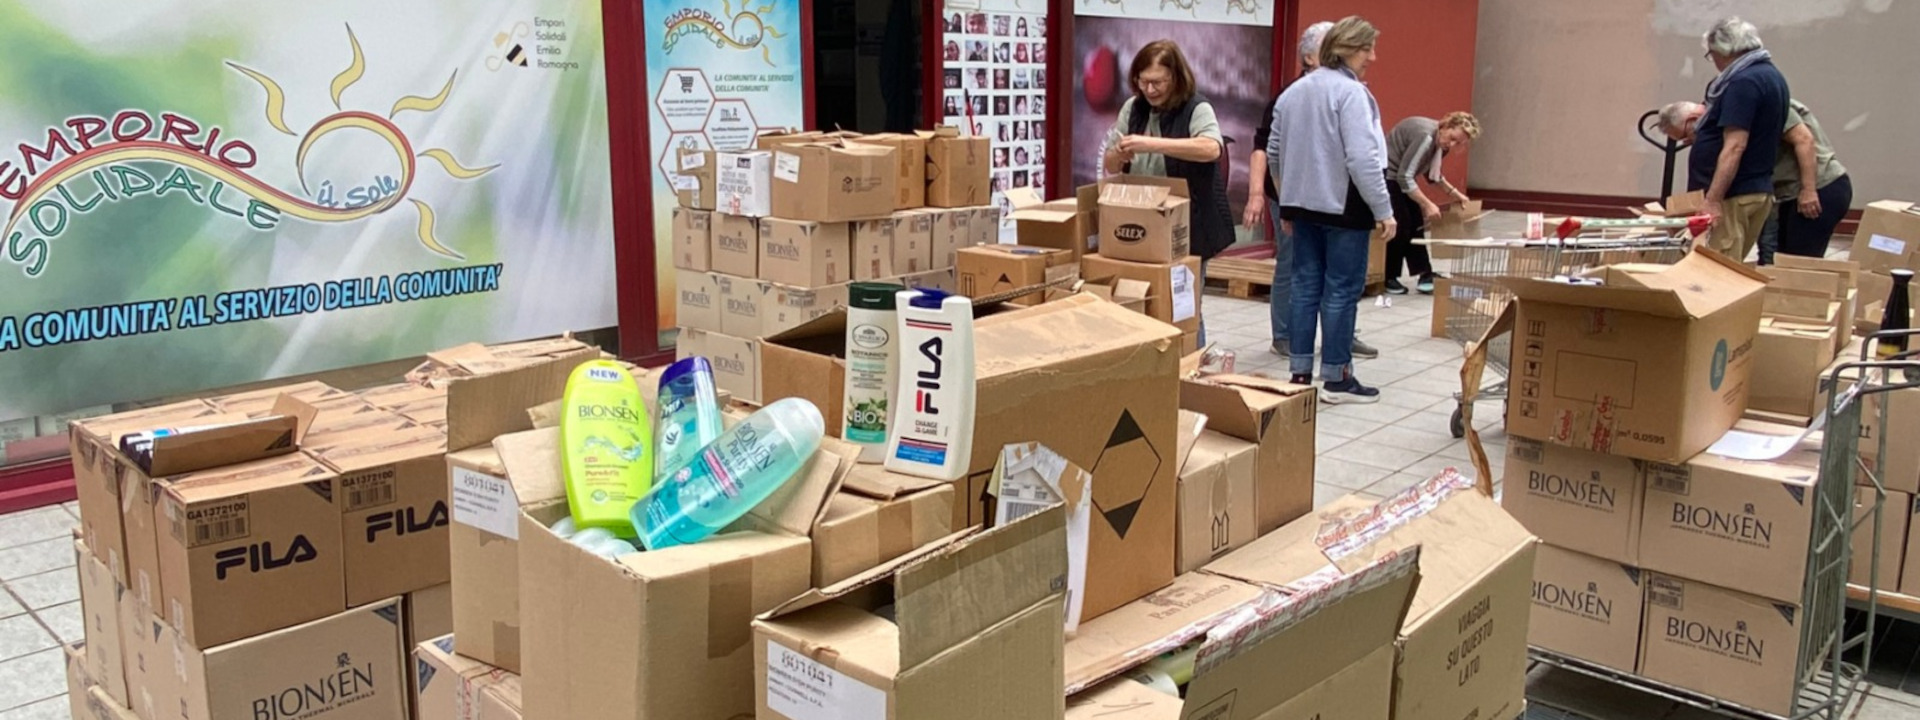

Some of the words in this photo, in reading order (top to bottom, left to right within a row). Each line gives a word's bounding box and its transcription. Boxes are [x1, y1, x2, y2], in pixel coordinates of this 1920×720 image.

[534, 16, 565, 29] Empori
[664, 8, 725, 31] EMPORIO
[535, 31, 566, 42] Solidali
[536, 45, 562, 56] Emilia
[662, 23, 725, 55] SOLIDALE
[537, 59, 579, 70] Romagna
[714, 74, 723, 82] LA
[767, 74, 794, 82] SERVIZIO
[0, 111, 257, 200] EMPORIO
[9, 165, 281, 276] SOLIDALE
[1115, 226, 1146, 240] SELEX
[22, 298, 178, 347] COMUNITA'
[177, 300, 212, 328] AL
[214, 284, 318, 324] SERVIZIO
[323, 279, 391, 309] DELLA
[394, 263, 504, 302] COMUNITA'
[589, 369, 618, 379] NEW
[915, 336, 943, 415] FILA
[578, 404, 639, 421] BIONSEN
[853, 410, 877, 424] BIO
[915, 419, 938, 429] CHANGE
[737, 422, 775, 470] BIONSEN
[342, 470, 394, 488] GA1372100
[1528, 469, 1616, 507] BIONSEN
[187, 502, 246, 520] GA1372100
[366, 499, 449, 543] FILA
[1672, 502, 1773, 543] BIONSEN
[215, 534, 318, 580] FILA
[1459, 595, 1490, 634] VIAGGIA
[1446, 645, 1460, 671] SU
[1461, 618, 1494, 659] QUESTO
[1666, 616, 1764, 660] BIONSEN
[1458, 655, 1480, 687] LATO
[252, 662, 374, 720] BIONSEN
[336, 690, 376, 708] MINERALS
